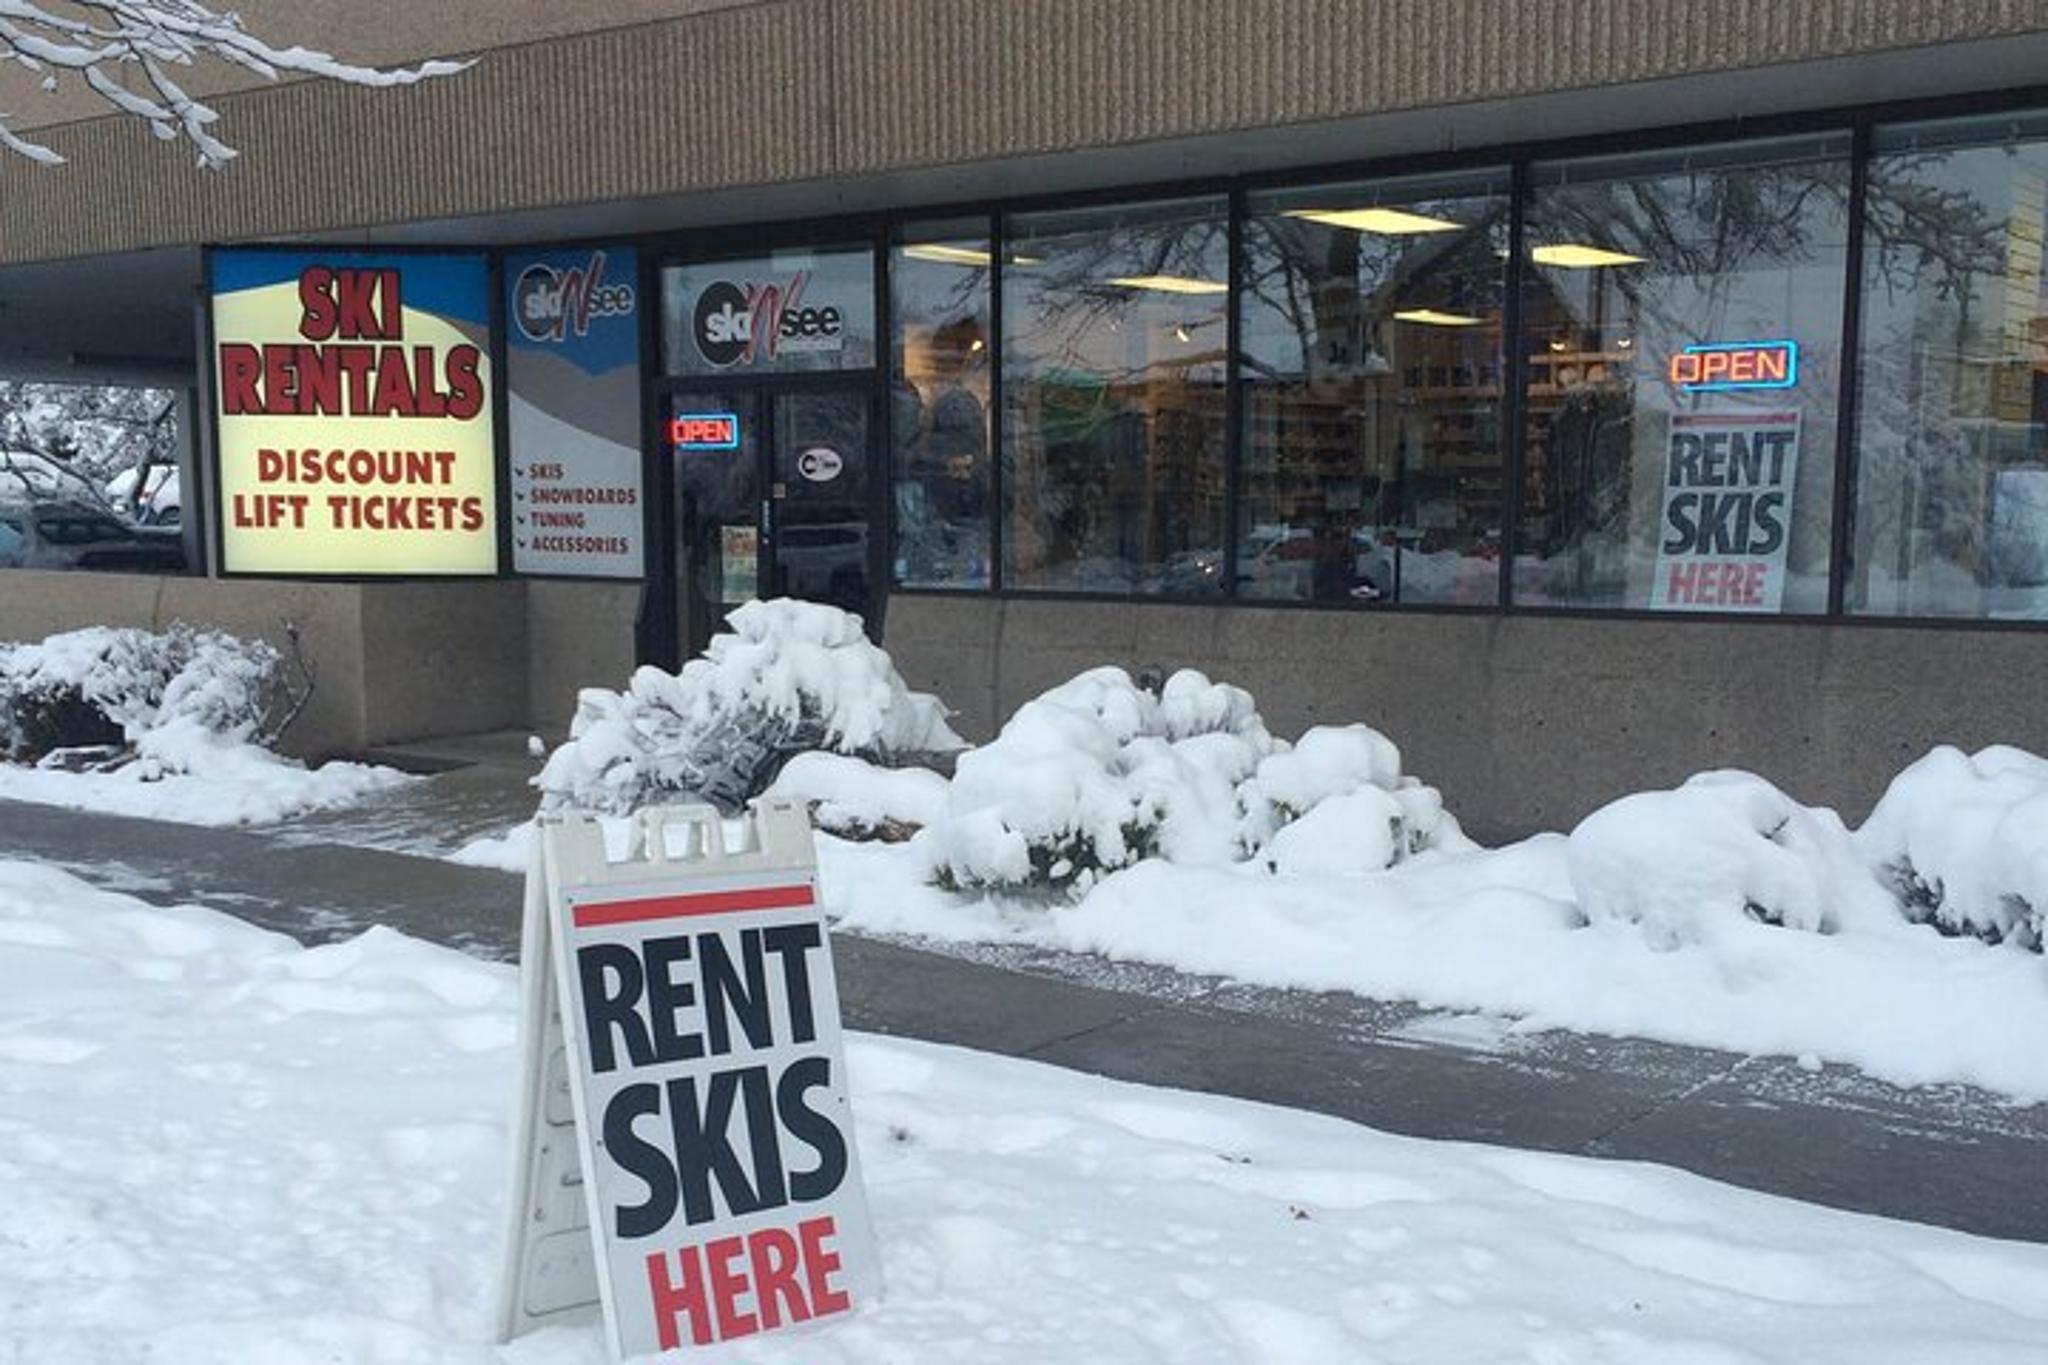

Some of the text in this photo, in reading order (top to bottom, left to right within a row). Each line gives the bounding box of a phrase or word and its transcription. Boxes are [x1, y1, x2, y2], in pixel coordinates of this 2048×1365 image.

[299, 266, 403, 342] SKI
[220, 343, 484, 421] RENTALS
[1670, 350, 1787, 384] OPEN
[672, 419, 732, 443] OPEN
[258, 449, 456, 484] DISCOUNT
[529, 463, 564, 480] SKIS
[1668, 431, 1796, 488] RENT
[233, 495, 484, 531] LIFT TICKETS
[531, 488, 637, 505] SNOWBOARDS
[531, 511, 585, 529] TUNING
[1662, 491, 1785, 556] SKIS
[532, 536, 629, 555] ACCESSORIES
[1666, 562, 1768, 605] HERE
[576, 922, 822, 1074] RENT
[601, 1056, 849, 1239] SKIS
[645, 1215, 851, 1351] HERE
